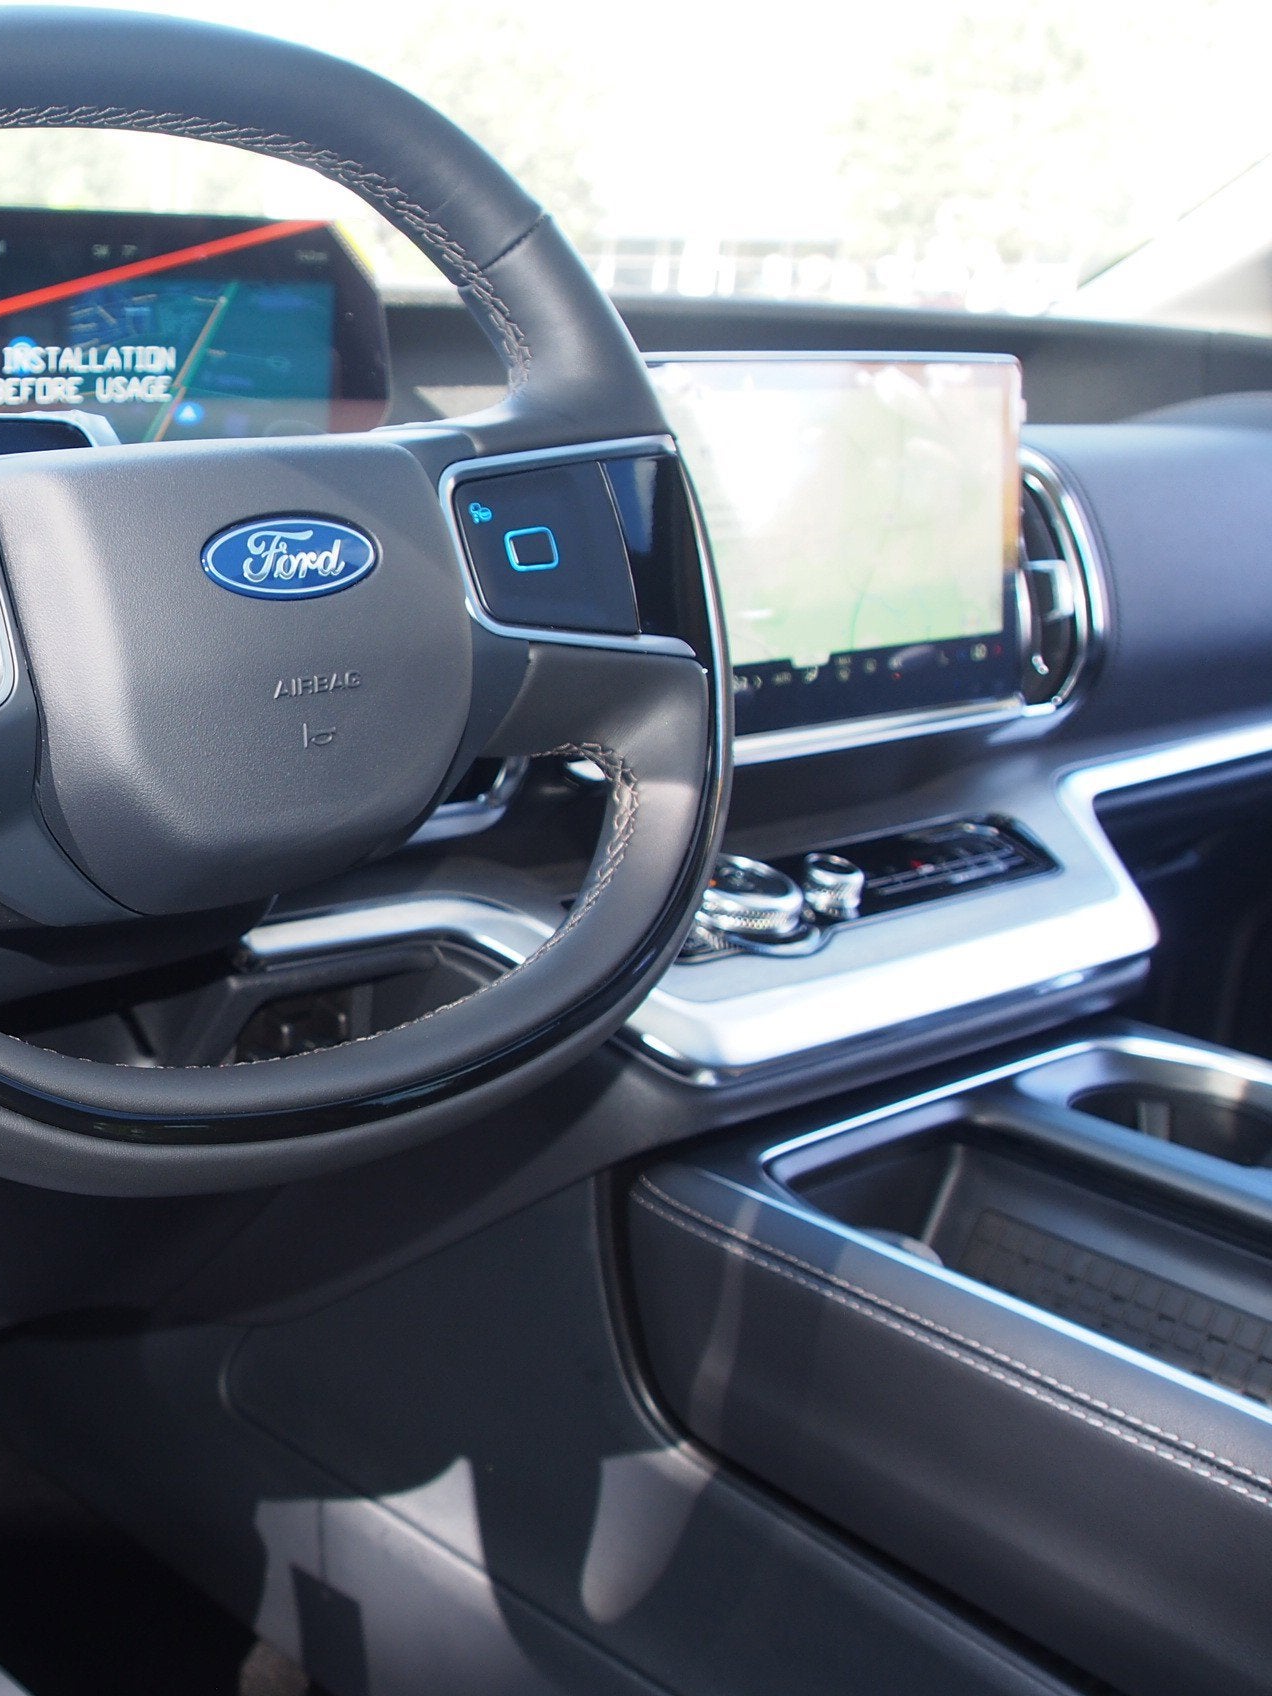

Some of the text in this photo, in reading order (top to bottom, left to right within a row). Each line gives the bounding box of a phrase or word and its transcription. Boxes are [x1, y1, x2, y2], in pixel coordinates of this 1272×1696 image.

[2, 345, 177, 375] INSTALLATION
[95, 375, 173, 404] USAGE
[242, 529, 346, 583] Ford
[273, 670, 362, 700] AIRBAG
